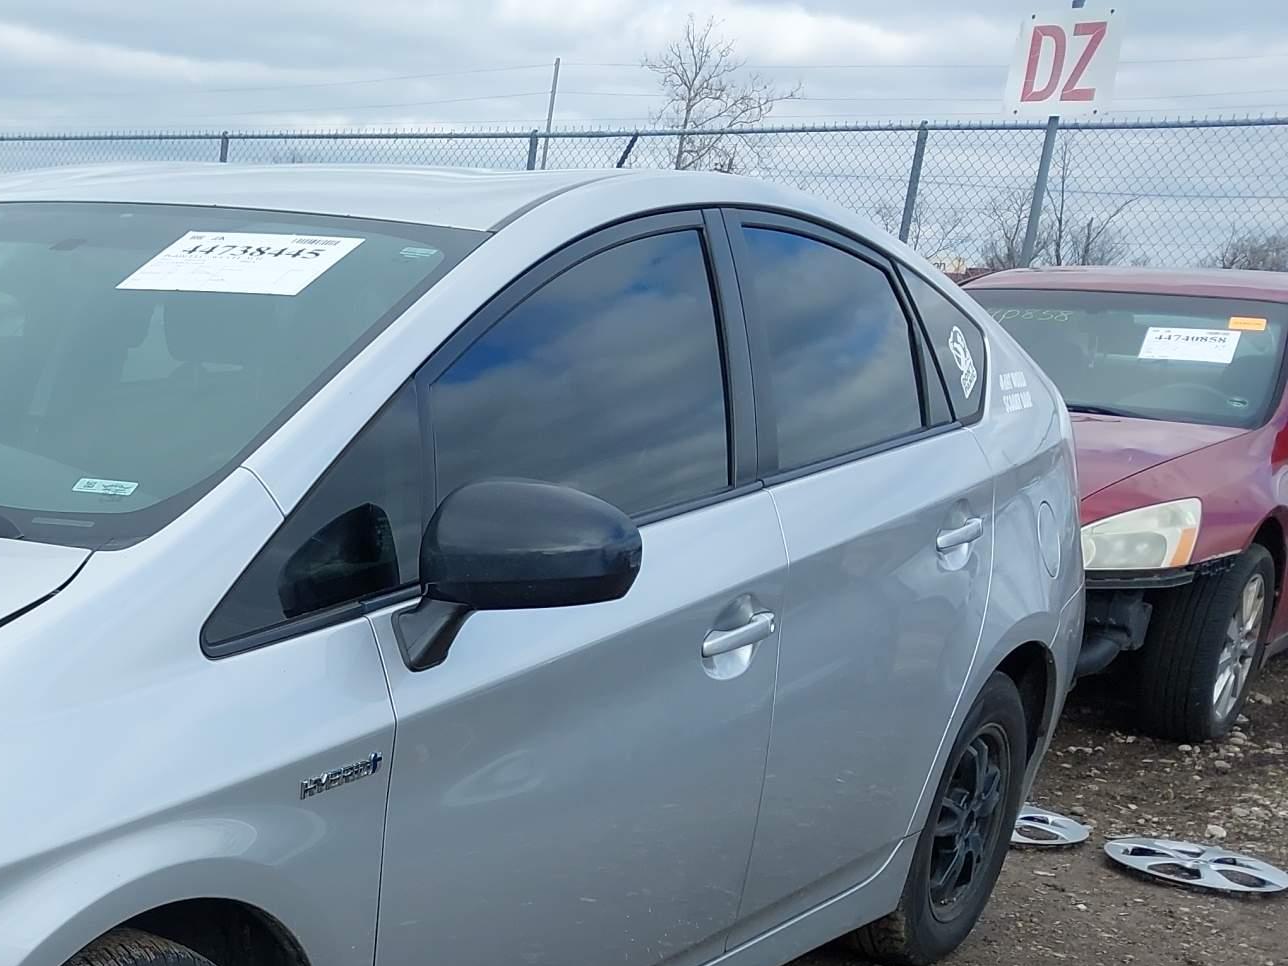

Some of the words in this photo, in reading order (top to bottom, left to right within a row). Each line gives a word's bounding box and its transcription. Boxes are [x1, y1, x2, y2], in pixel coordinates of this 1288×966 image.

[1020, 21, 1108, 102] DZ
[182, 244, 327, 260] 44738445
[1155, 334, 1227, 344] 44740858
